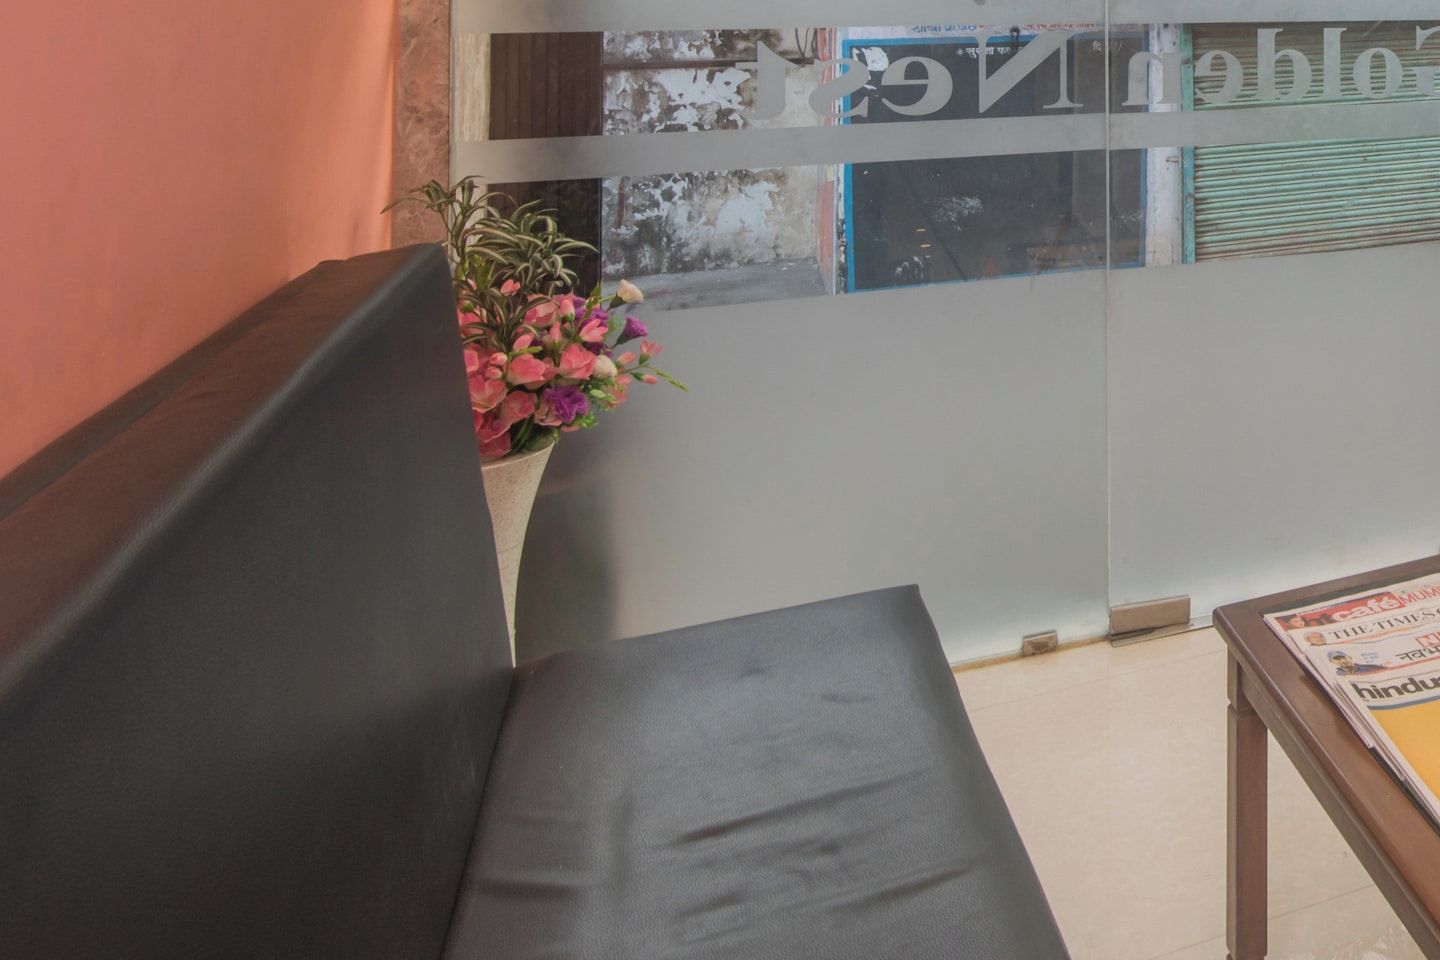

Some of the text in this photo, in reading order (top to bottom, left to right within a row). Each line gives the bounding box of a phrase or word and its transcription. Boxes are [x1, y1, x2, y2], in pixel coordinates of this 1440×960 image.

[1331, 596, 1401, 622] café
[1328, 618, 1372, 641] THE
[1371, 609, 1437, 633] TIMES
